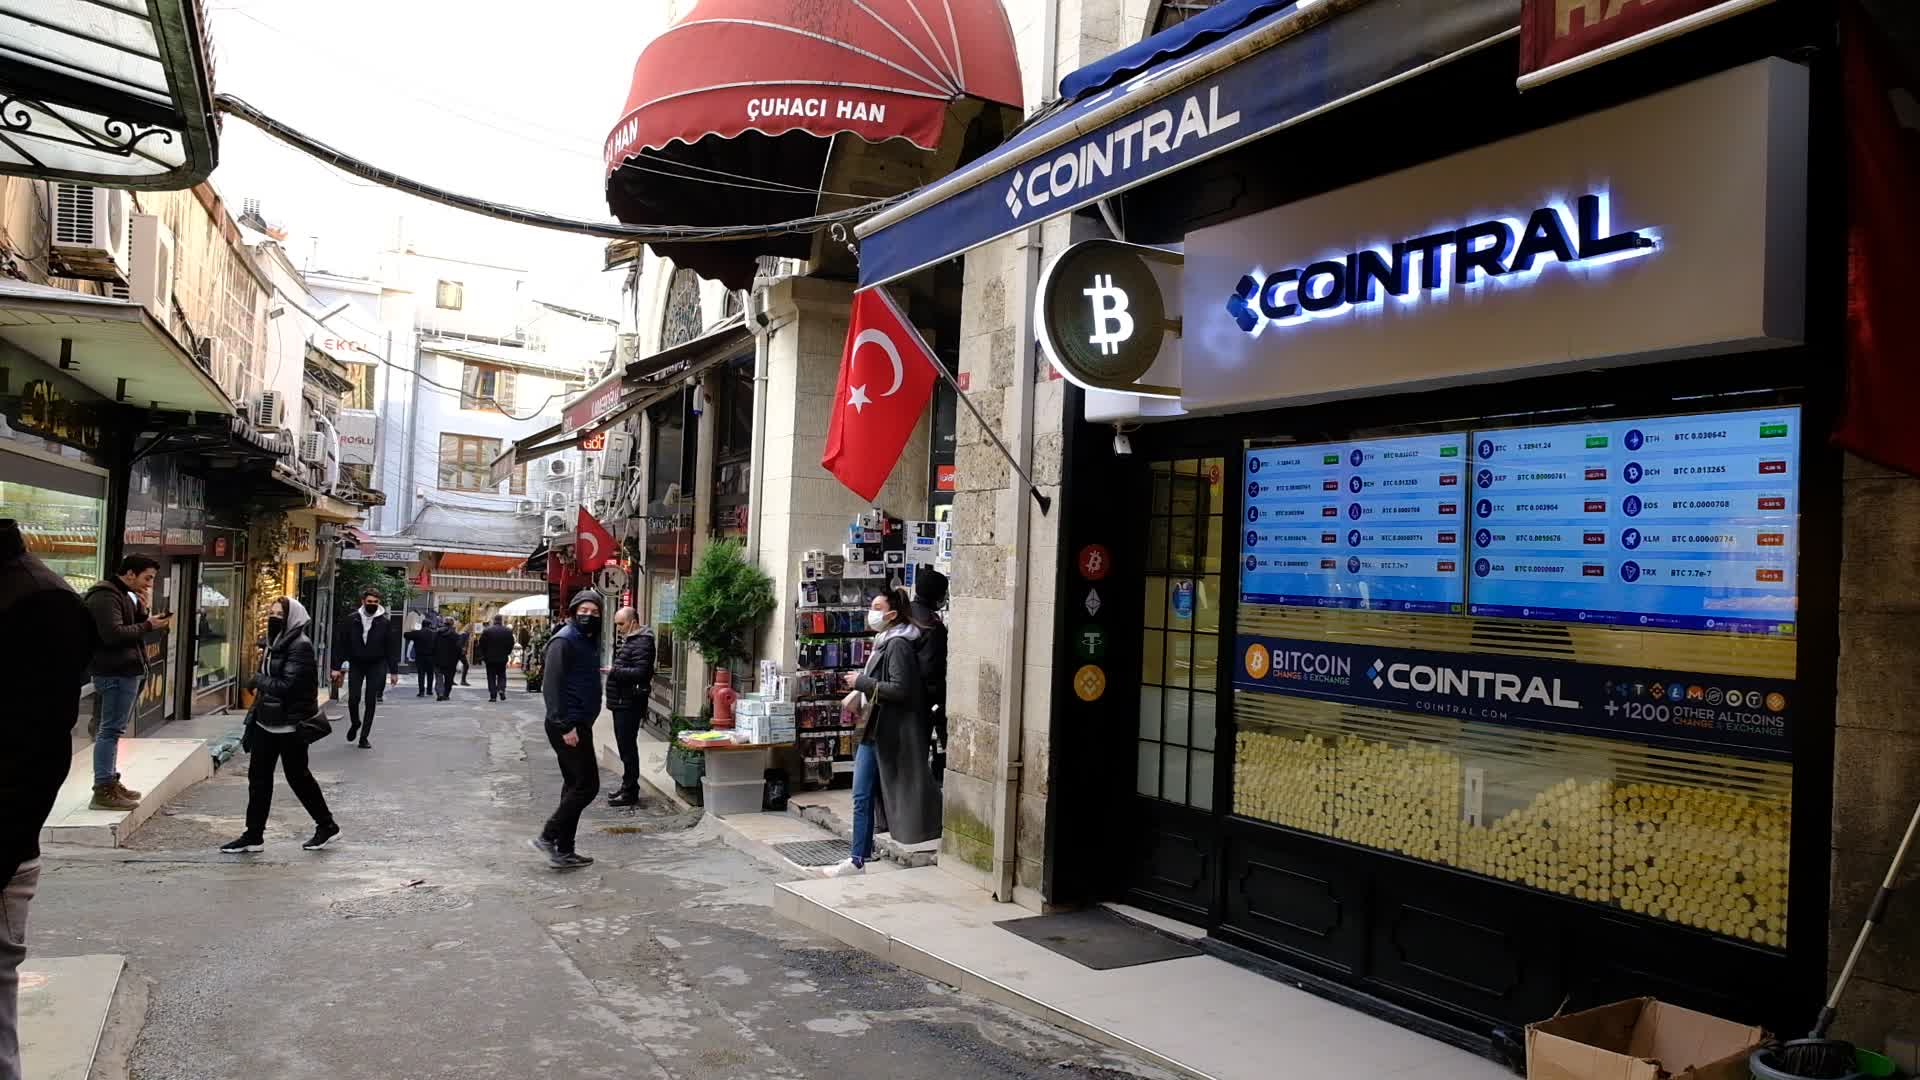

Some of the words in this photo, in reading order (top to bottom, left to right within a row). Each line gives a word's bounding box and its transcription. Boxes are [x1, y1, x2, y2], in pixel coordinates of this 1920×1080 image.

[747, 97, 827, 121] ÇUHACI
[836, 100, 886, 123] HAN
[615, 116, 639, 156] HAN
[1026, 85, 1241, 207] COINTRAL
[1259, 194, 1643, 320] COINTRAL
[1645, 435, 1660, 443] ETH
[1674, 433, 1689, 441] BTC
[1690, 465, 1726, 474] 0.013265
[1672, 501, 1688, 509] BTC
[1671, 535, 1687, 543] BTC
[1671, 569, 1686, 577] BTC
[1687, 569, 1712, 577] 7.7e-7
[1272, 649, 1351, 677] BITCOIN
[1273, 669, 1302, 681] CHANGE
[1309, 673, 1351, 686] EXCHANGE
[1387, 663, 1580, 709] COINTRAL
[1672, 717, 1714, 729] CHANGE
[1726, 723, 1785, 737] EXCHANGE
[1673, 705, 1715, 720] OTHER
[1718, 711, 1785, 728] ALTCOINS
